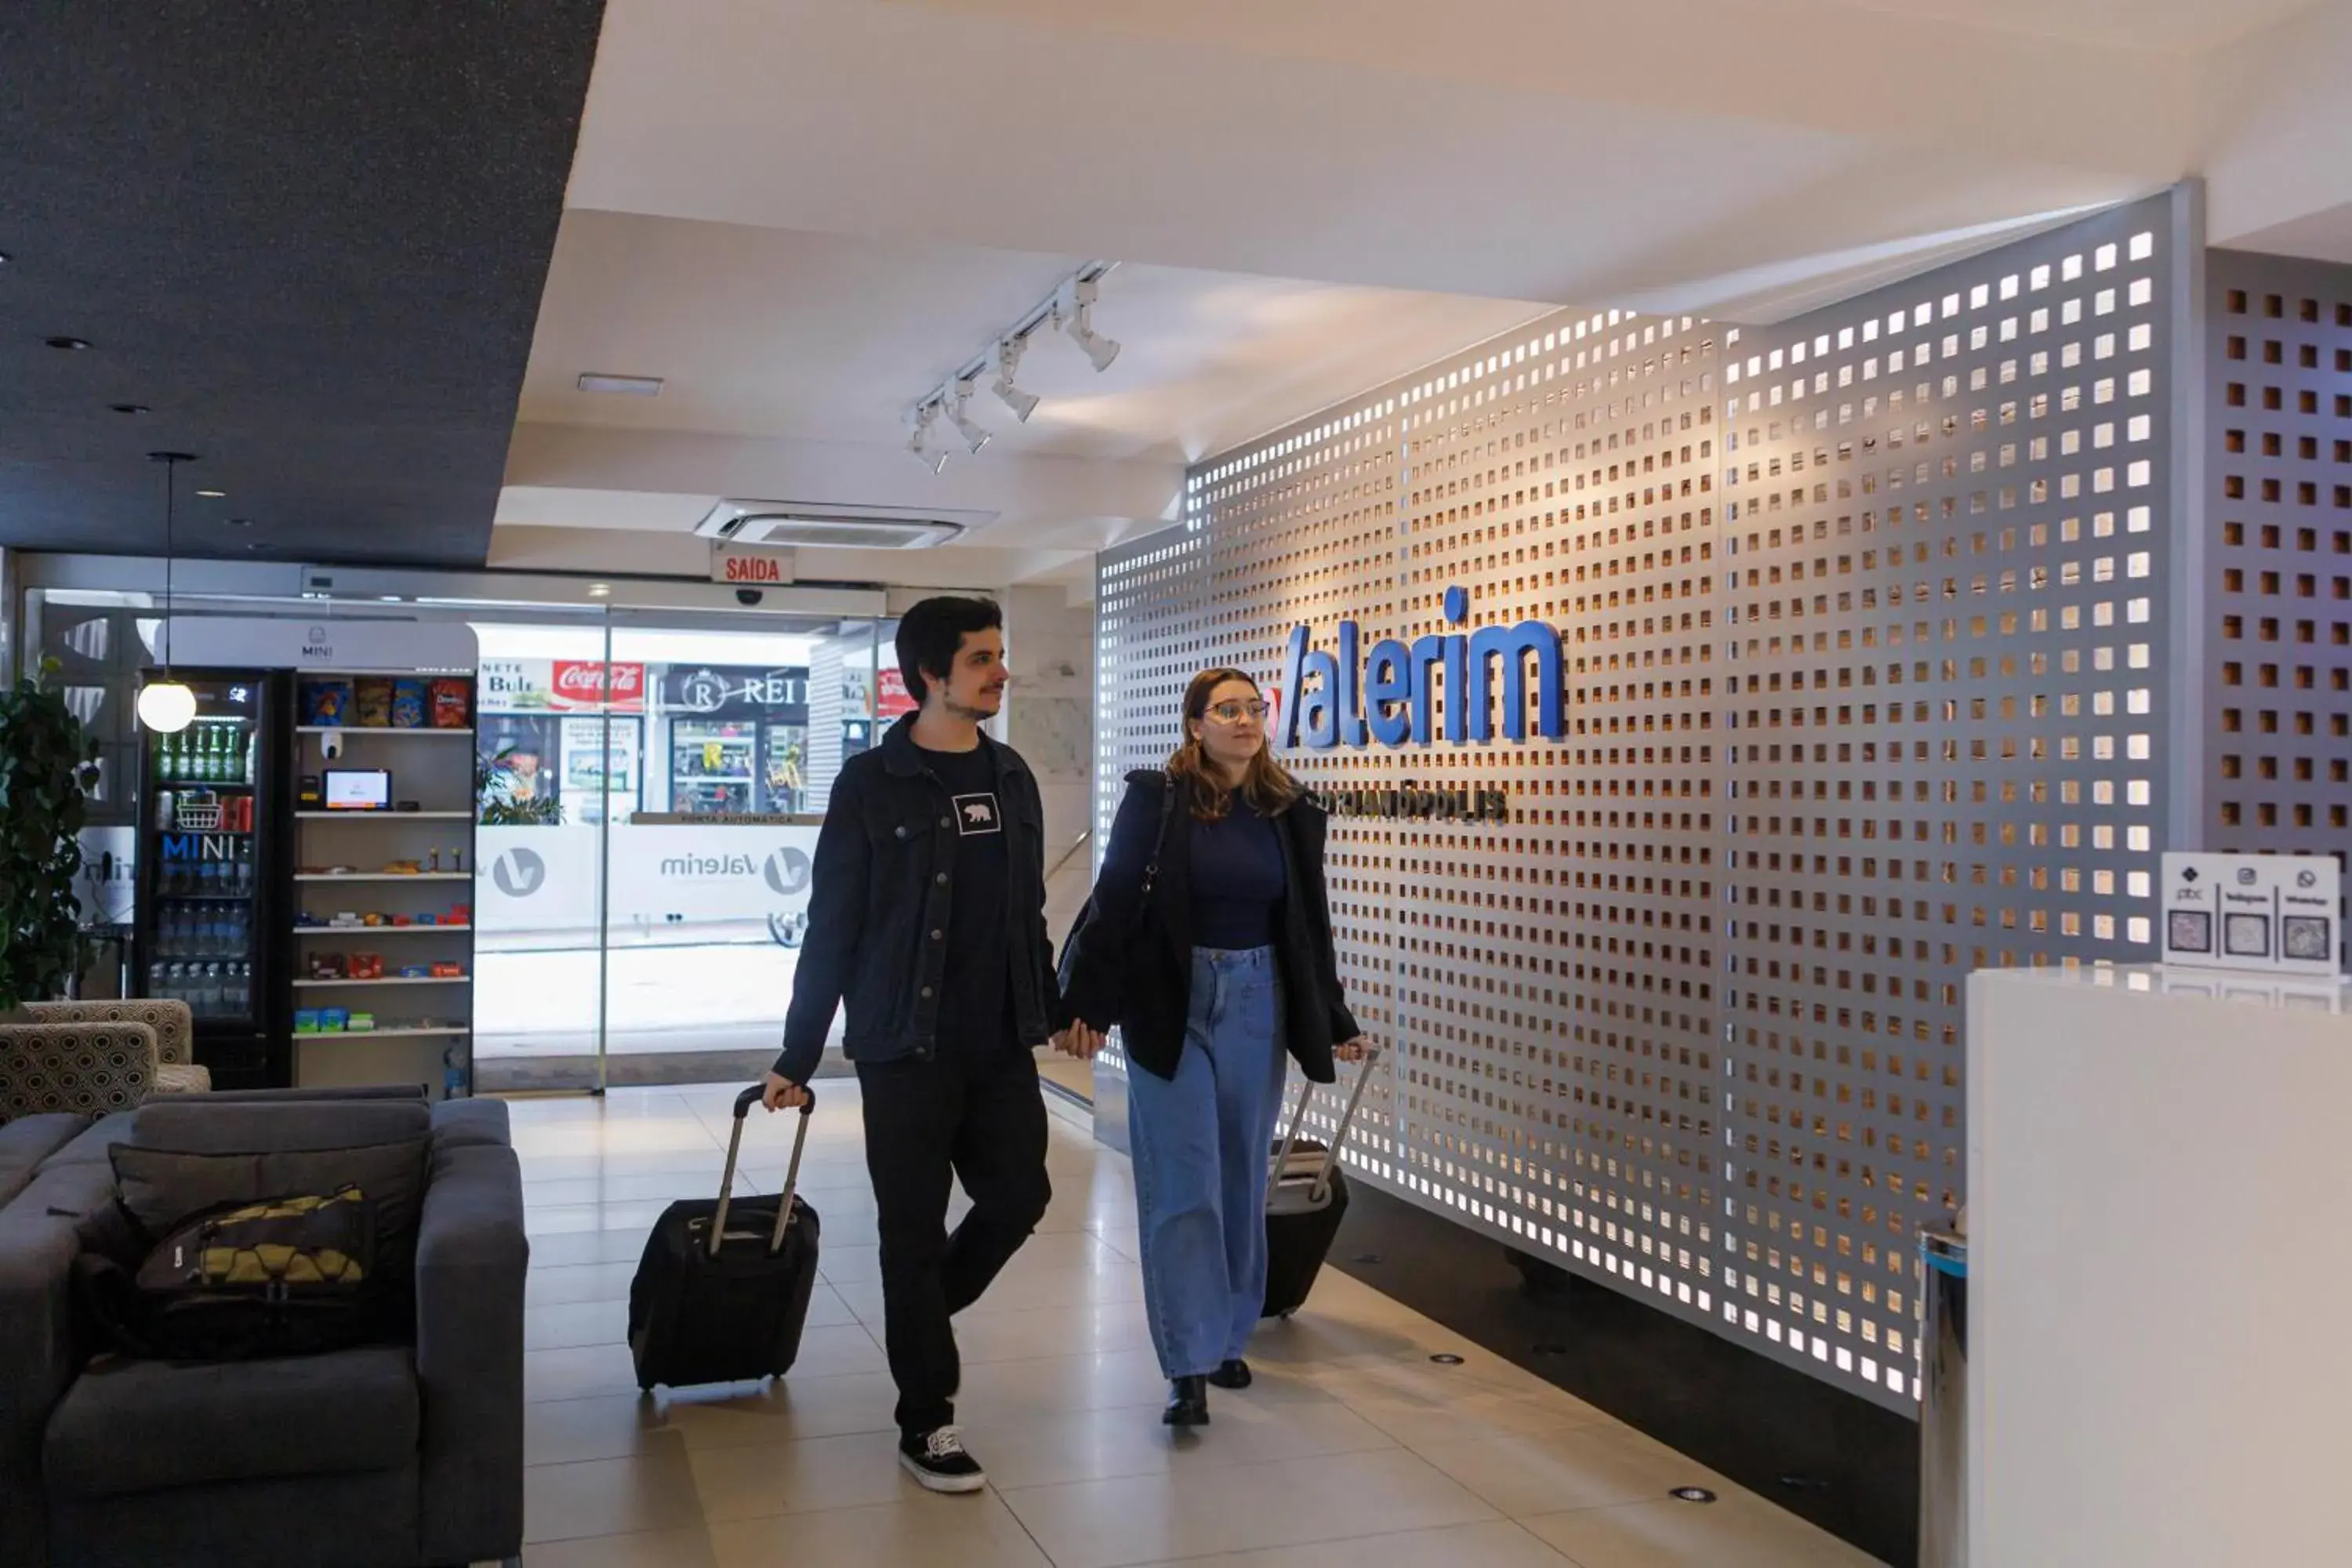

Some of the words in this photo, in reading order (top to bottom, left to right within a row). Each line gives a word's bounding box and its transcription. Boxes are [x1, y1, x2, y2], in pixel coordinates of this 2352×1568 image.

[726, 556, 779, 581] SAÍDA
[302, 646, 333, 657] MINI
[1265, 585, 1565, 749] Valerim
[695, 684, 713, 706] R
[1309, 779, 1507, 820] ORIANÓPOLIS
[162, 835, 234, 860] MINI
